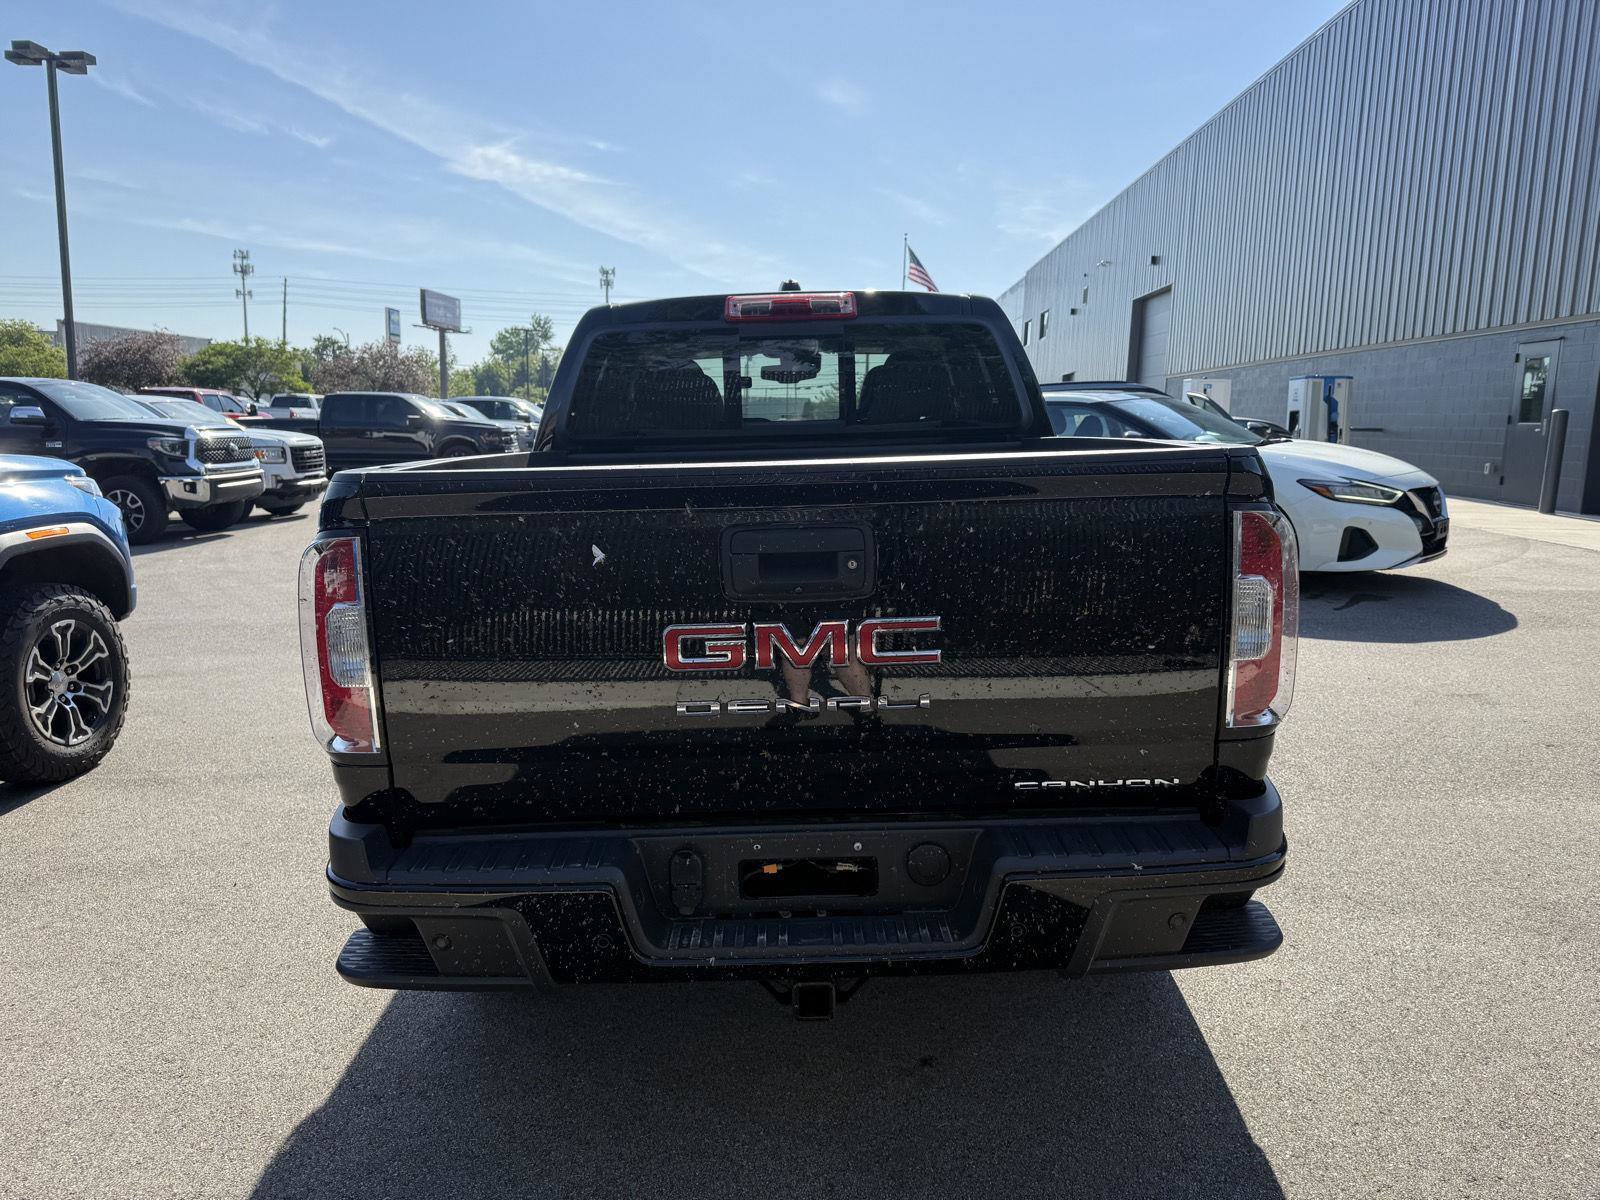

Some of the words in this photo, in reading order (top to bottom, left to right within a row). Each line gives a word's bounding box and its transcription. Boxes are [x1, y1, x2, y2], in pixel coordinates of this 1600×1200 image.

[662, 615, 942, 672] GMC
[676, 693, 931, 717] DENALI
[1014, 778, 1180, 790] CANYON
